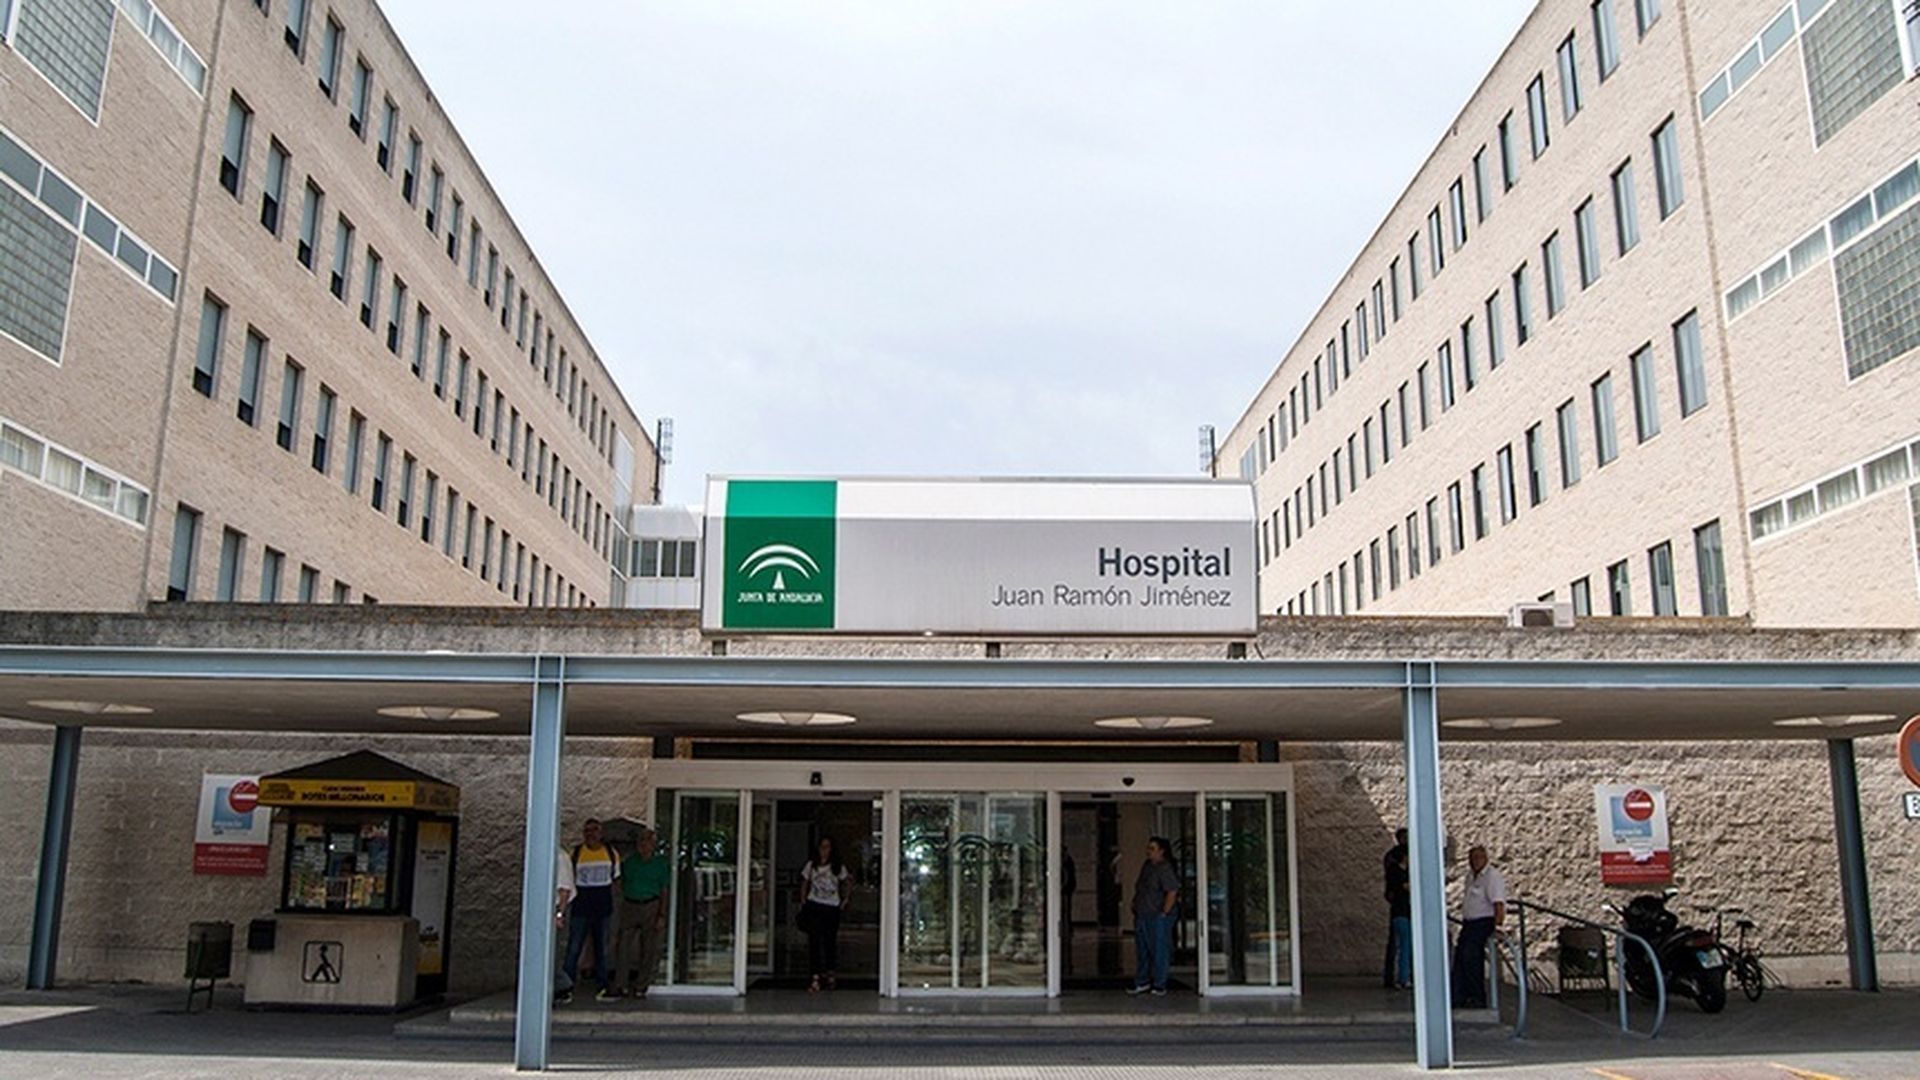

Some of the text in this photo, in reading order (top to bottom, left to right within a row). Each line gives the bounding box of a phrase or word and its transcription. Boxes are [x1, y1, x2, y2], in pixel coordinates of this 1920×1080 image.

[1100, 547, 1231, 581] Hospital
[737, 592, 764, 603] JUNTA
[766, 592, 777, 603] DE
[991, 582, 1231, 607] Juan Ramón Jiménez
